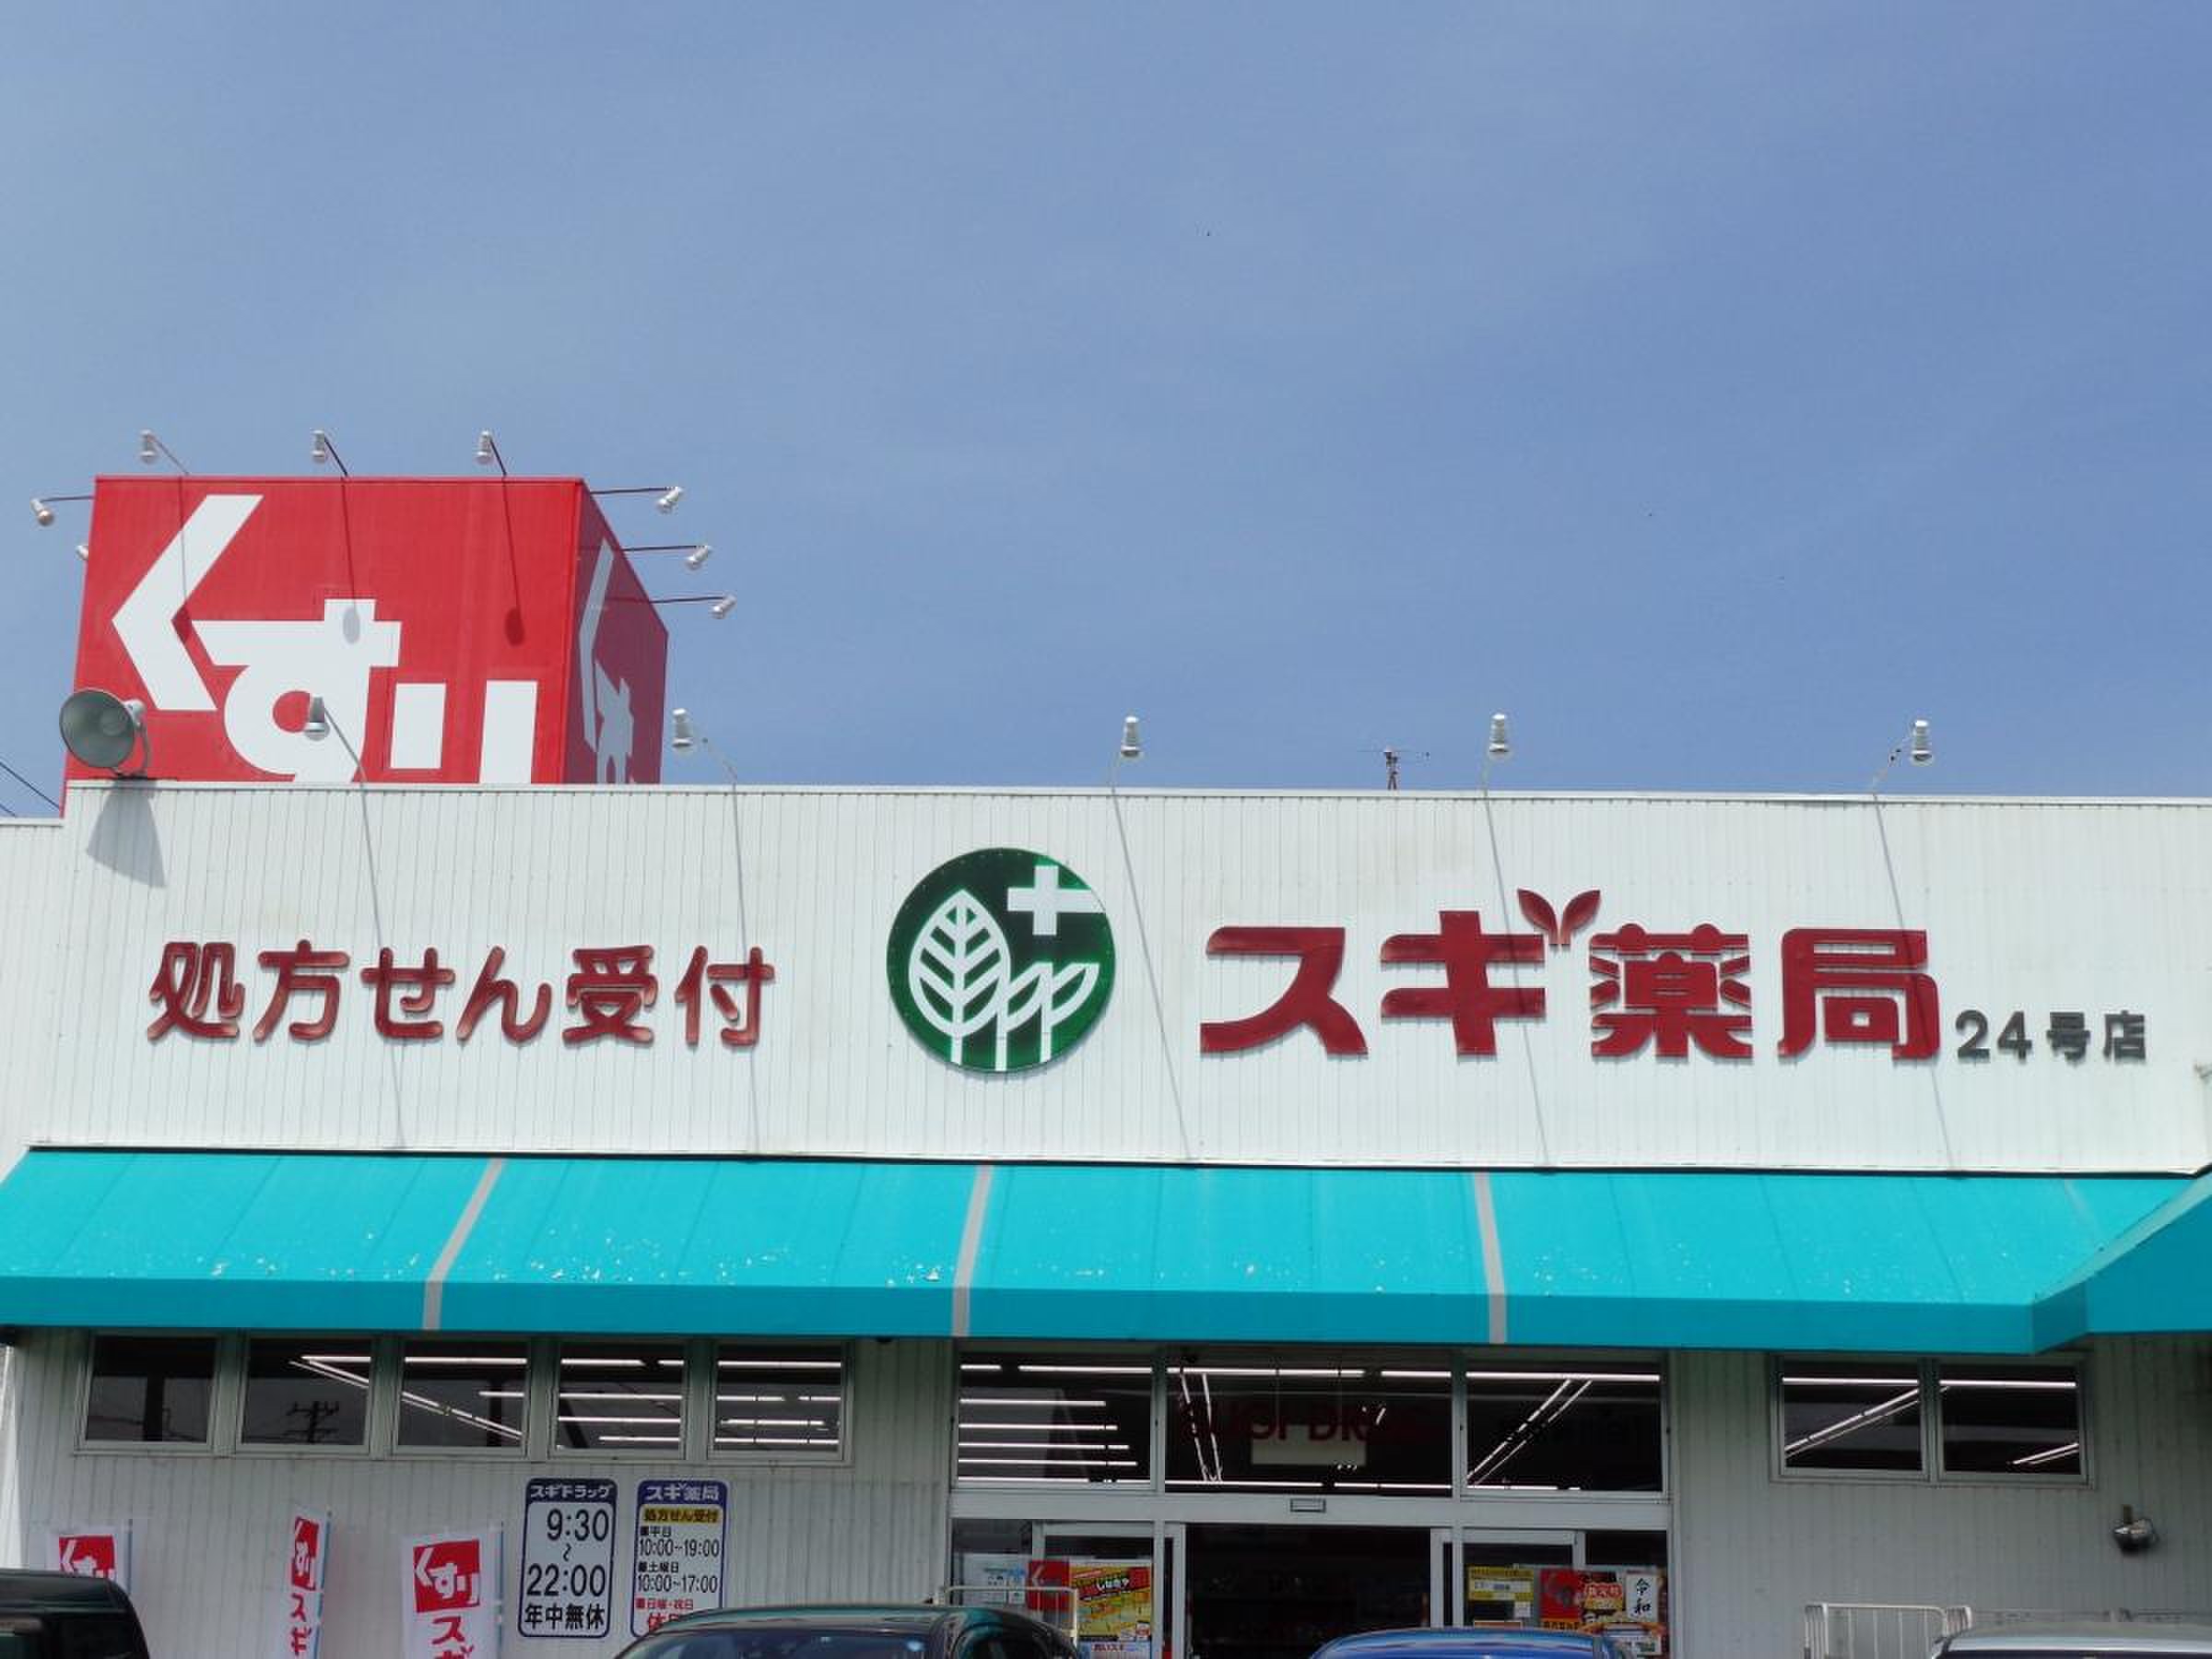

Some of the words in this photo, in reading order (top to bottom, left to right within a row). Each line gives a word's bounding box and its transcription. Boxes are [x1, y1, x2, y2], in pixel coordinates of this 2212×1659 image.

[112, 494, 537, 782] くすり
[148, 940, 775, 1045] 処方せん受付
[1200, 889, 1941, 1062] スギ薬局
[1956, 1009, 2147, 1063] 24号店
[529, 1484, 614, 1499] スギドラッグ
[646, 1483, 720, 1501] スギ薬局
[547, 1509, 609, 1542] 9:30
[415, 1547, 480, 1605] くすり
[526, 1564, 606, 1597] 22:00
[524, 1603, 606, 1630] 年中無休
